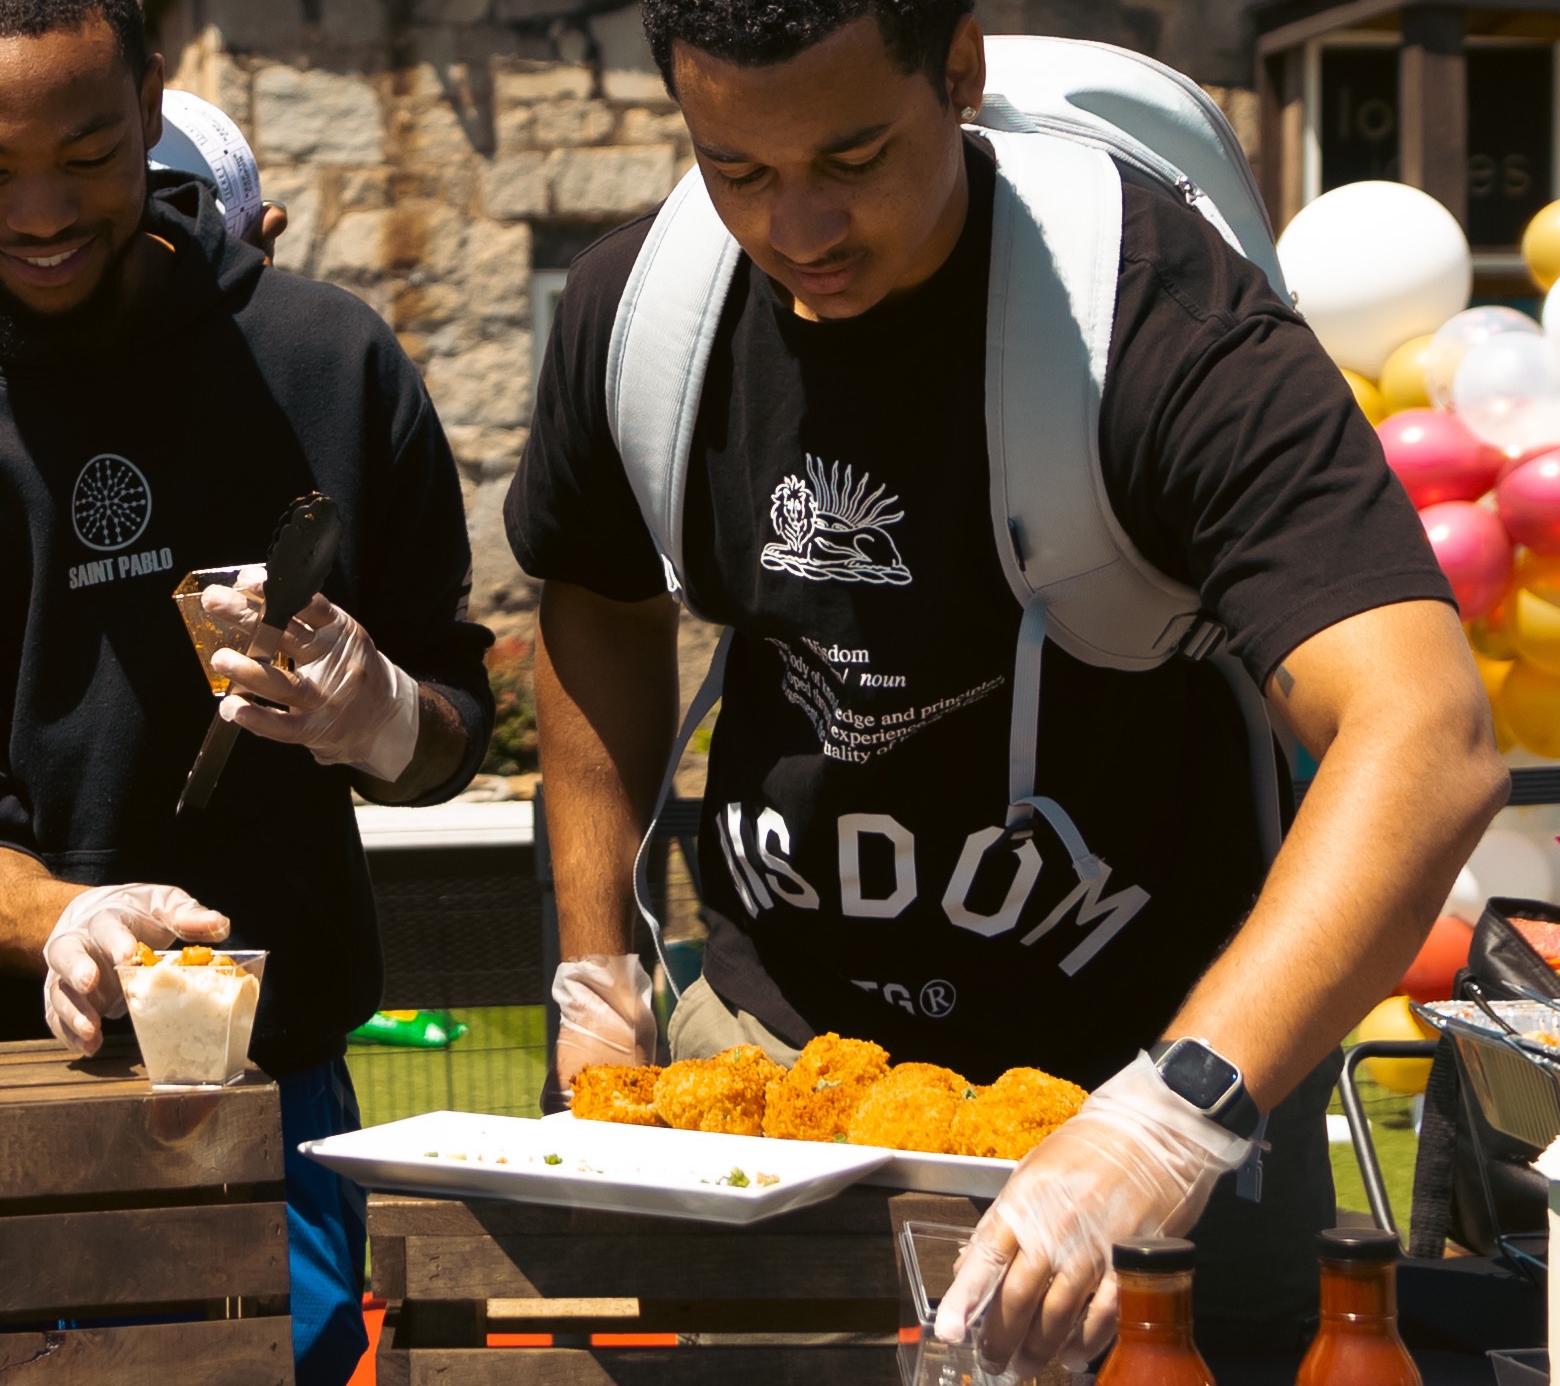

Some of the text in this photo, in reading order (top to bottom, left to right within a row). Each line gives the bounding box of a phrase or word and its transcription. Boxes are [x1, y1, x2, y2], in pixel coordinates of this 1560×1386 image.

[69, 547, 173, 589] SAINT PABLO
[859, 671, 907, 688] noun
[881, 707, 915, 725] and
[716, 802, 1151, 977] ISDOM
